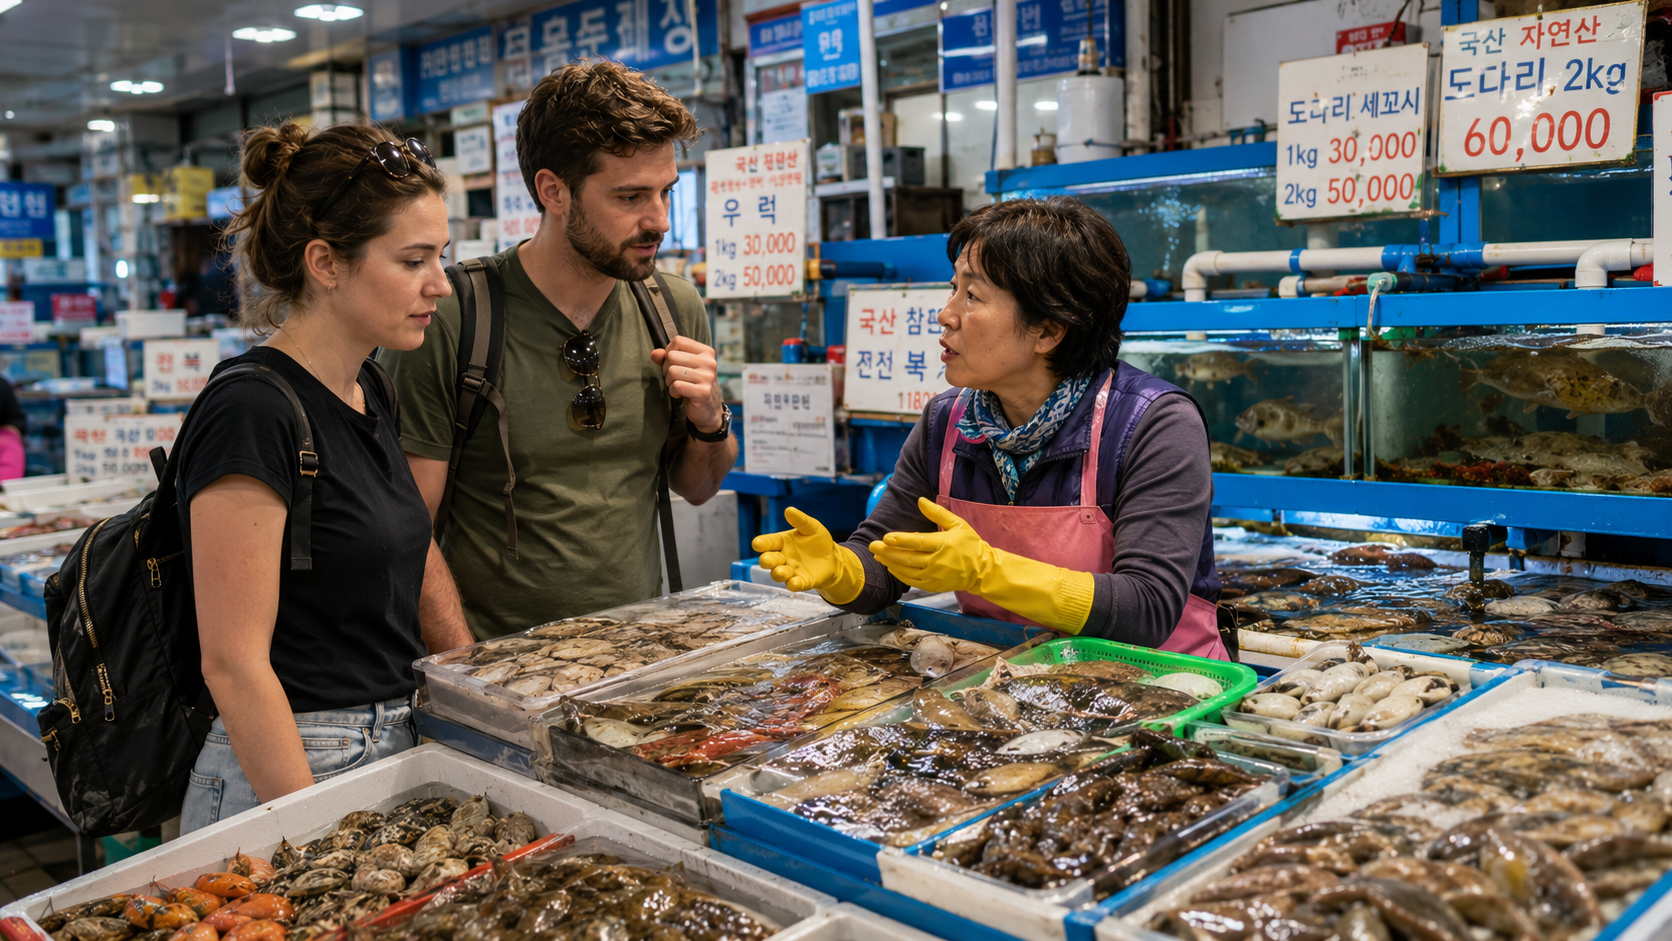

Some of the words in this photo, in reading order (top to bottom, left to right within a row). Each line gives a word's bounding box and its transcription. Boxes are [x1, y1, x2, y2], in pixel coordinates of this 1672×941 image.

[1459, 27, 1506, 55] 국산
[1520, 15, 1601, 49] 자연산
[1445, 57, 1546, 101] 도다리
[1563, 57, 1627, 95] 2kg
[1286, 144, 1318, 169] 1kg
[1328, 131, 1417, 167] 30,000
[1464, 108, 1611, 162] 60,000
[1284, 183, 1317, 208] 2kg
[1327, 173, 1415, 208] 50,000
[715, 239, 737, 260] 1kg
[743, 232, 796, 258] 30,000
[714, 269, 737, 291] 2kg
[743, 264, 796, 290] 50,000
[859, 307, 897, 336] 국산
[904, 351, 928, 383] 복
